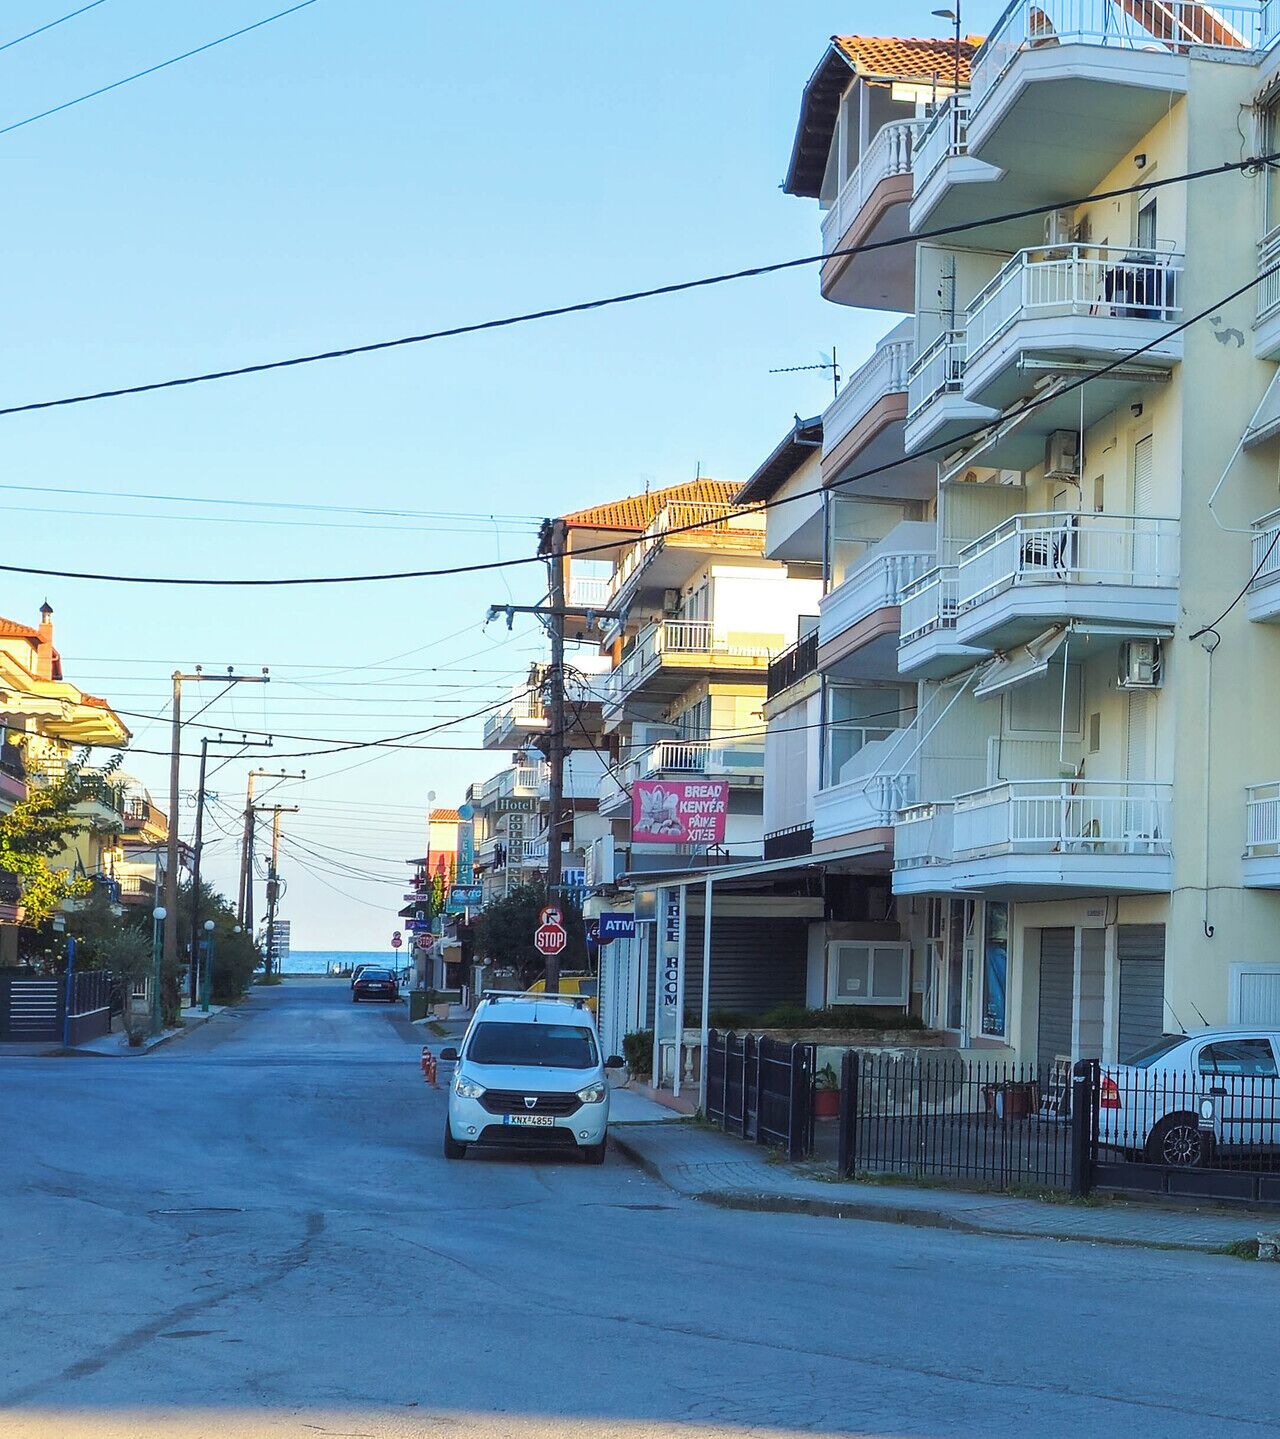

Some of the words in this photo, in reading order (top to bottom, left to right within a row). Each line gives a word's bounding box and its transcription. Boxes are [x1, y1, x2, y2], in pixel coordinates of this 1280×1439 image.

[685, 785, 722, 798] BREAD
[500, 799, 533, 810] Hotel
[679, 798, 725, 813] KENYÉR
[667, 891, 680, 942] FREE
[605, 920, 634, 931] ATM
[418, 936, 433, 946] STOP
[538, 932, 563, 947] STOP
